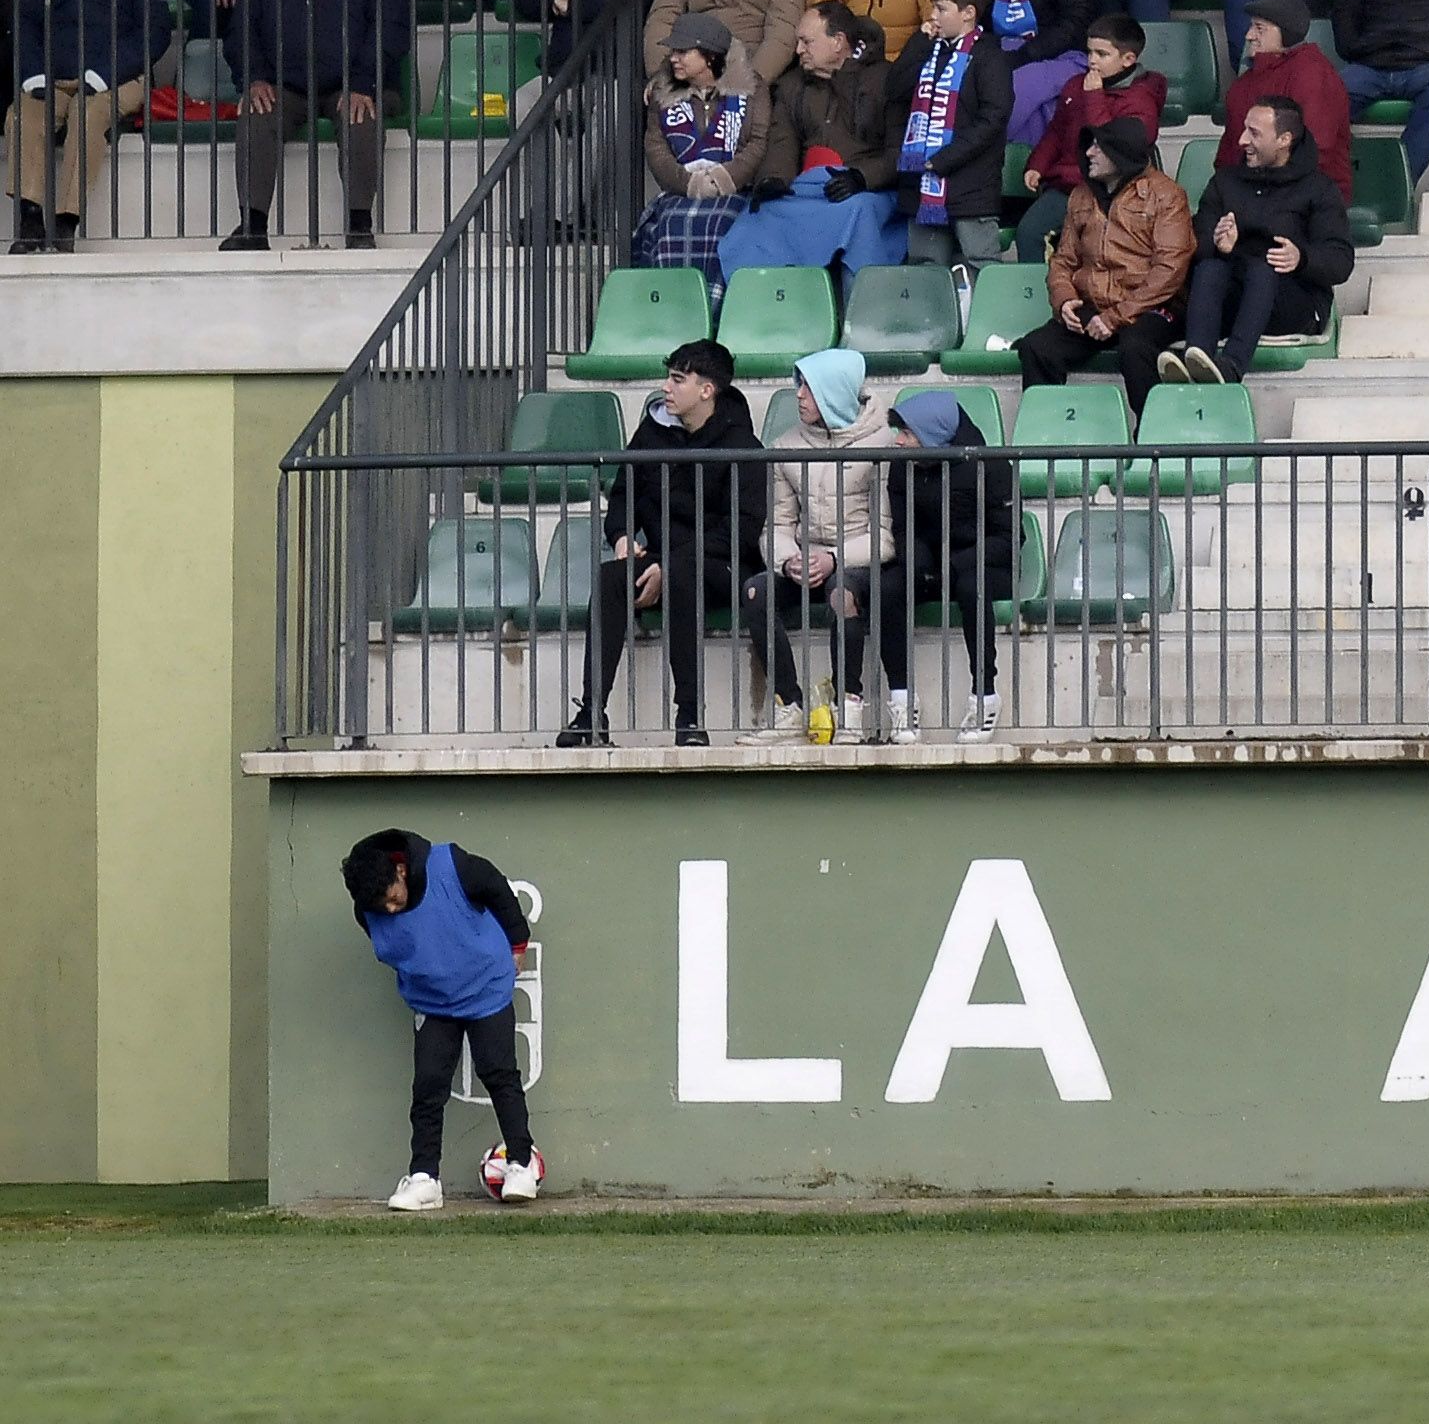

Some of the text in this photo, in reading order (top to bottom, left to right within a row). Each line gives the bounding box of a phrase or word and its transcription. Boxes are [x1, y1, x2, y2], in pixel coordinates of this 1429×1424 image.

[650, 290, 660, 303] 6
[776, 289, 786, 302] 5
[899, 287, 910, 300] 4
[1023, 286, 1034, 300] 3
[1065, 408, 1076, 421] 2
[1195, 408, 1203, 421] 1
[475, 541, 486, 554] 6
[678, 860, 1111, 1103] LA
